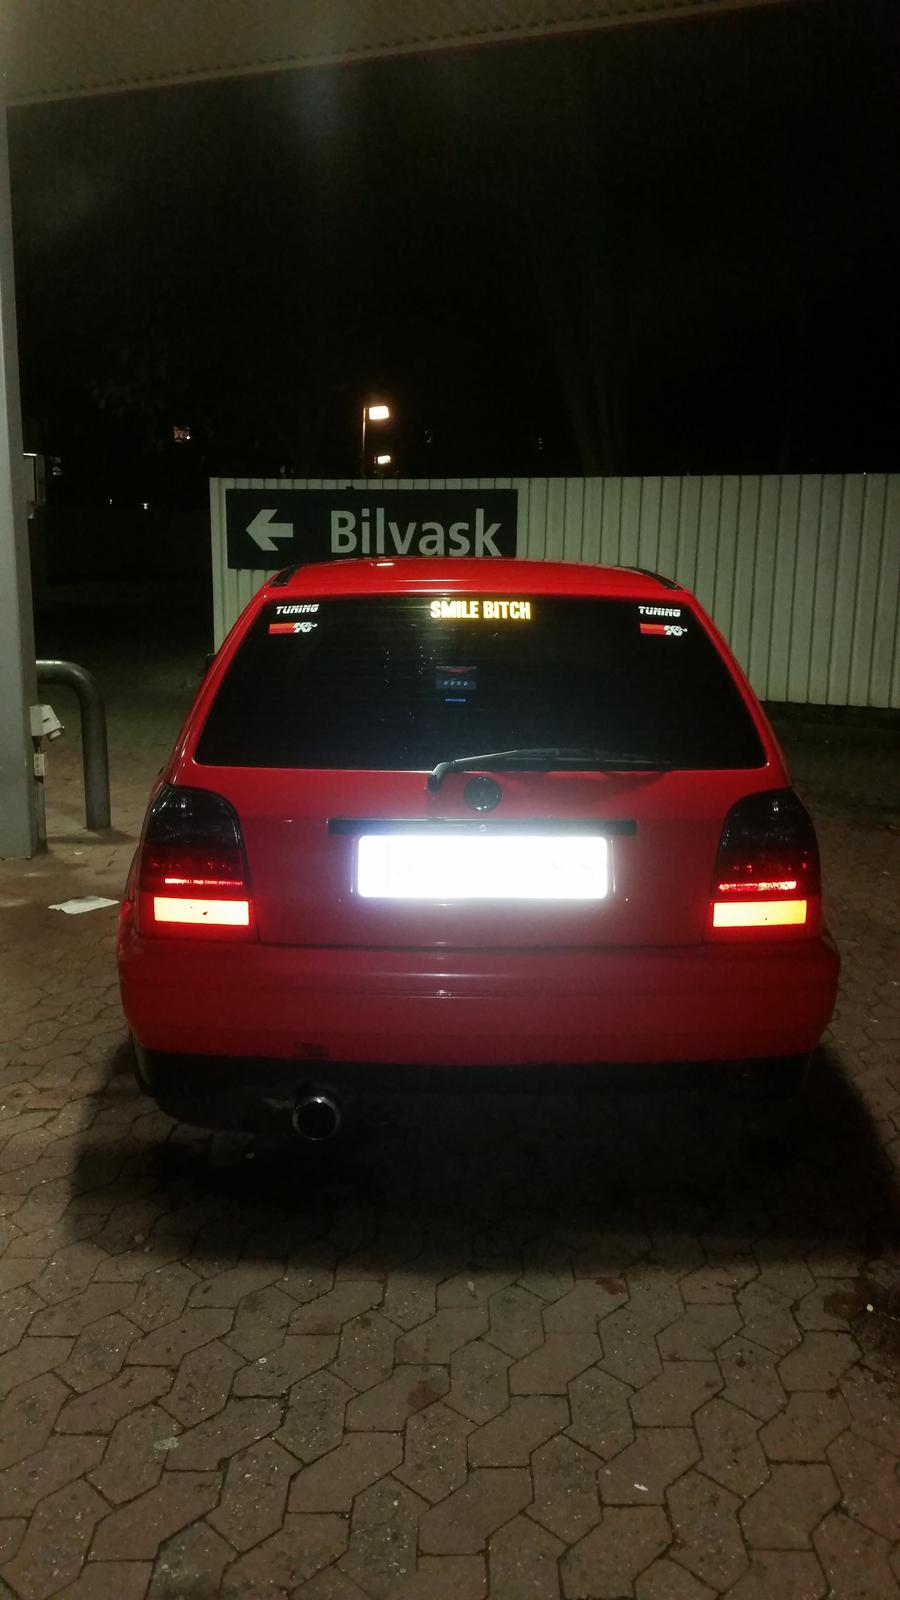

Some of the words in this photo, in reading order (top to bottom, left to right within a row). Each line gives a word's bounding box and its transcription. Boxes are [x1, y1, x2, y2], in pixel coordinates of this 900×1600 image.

[330, 507, 502, 557] Bilvask
[276, 603, 320, 615] TUNING
[430, 600, 480, 619] SMILE
[483, 601, 531, 620] BITCH
[638, 605, 681, 618] TUNING
